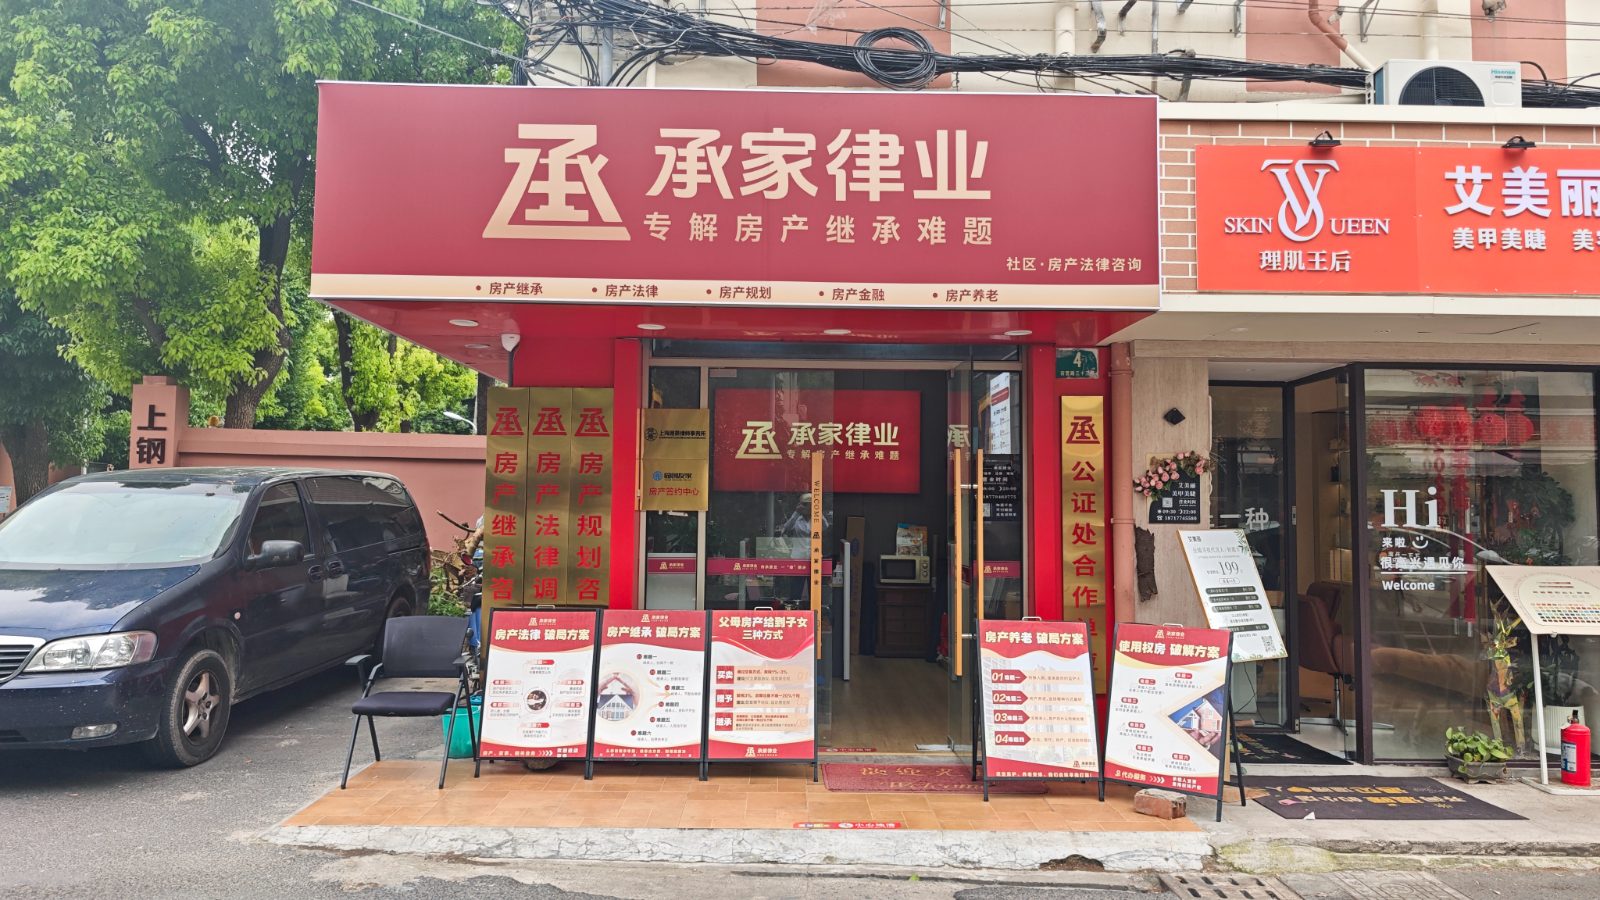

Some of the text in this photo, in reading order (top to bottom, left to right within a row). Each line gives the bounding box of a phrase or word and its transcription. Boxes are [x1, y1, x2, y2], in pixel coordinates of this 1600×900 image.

[644, 127, 991, 201] 承家律业
[1443, 164, 1600, 217] 艾美丽
[642, 211, 994, 246] 专解房产继承难题
[1224, 217, 1273, 234] SKIN
[1453, 228, 1546, 251] 美甲美睫
[1006, 256, 1142, 273] 社区·房产法律咨询
[1259, 250, 1351, 272] 理肌王后
[489, 280, 999, 303] 房产继承 房产法律 房产规划 房产金融 房产养老
[1073, 351, 1082, 368] 4
[136, 404, 167, 464] 上钢
[787, 422, 900, 446] 承家律业
[787, 449, 900, 461] 专解产继承难题
[649, 487, 699, 496] 房产签约中心
[1380, 486, 1441, 528] Hi
[489, 451, 517, 600] 房产继承咨
[533, 451, 561, 600] 房产法律调
[576, 452, 603, 601] 房产规划咨
[1382, 537, 1407, 548] 来啦
[1218, 561, 1239, 575] 199
[1380, 556, 1465, 569] 很高兴遇见你
[1382, 580, 1435, 590] Welcome
[719, 616, 808, 628] 父母房产给到子女
[495, 629, 590, 641] 房产法律 破局方案
[607, 626, 701, 639] 房产继承 破局方案
[742, 630, 783, 640] 三种方式
[985, 631, 1084, 645] 房产养老 破局方案
[1119, 640, 1220, 659] 使用权房 破解方案
[717, 670, 734, 679] 买卖
[992, 672, 1004, 681] 01
[993, 693, 1006, 703] 02
[715, 717, 732, 727] 继承
[994, 713, 1007, 722] 03
[995, 734, 1008, 744] 04
